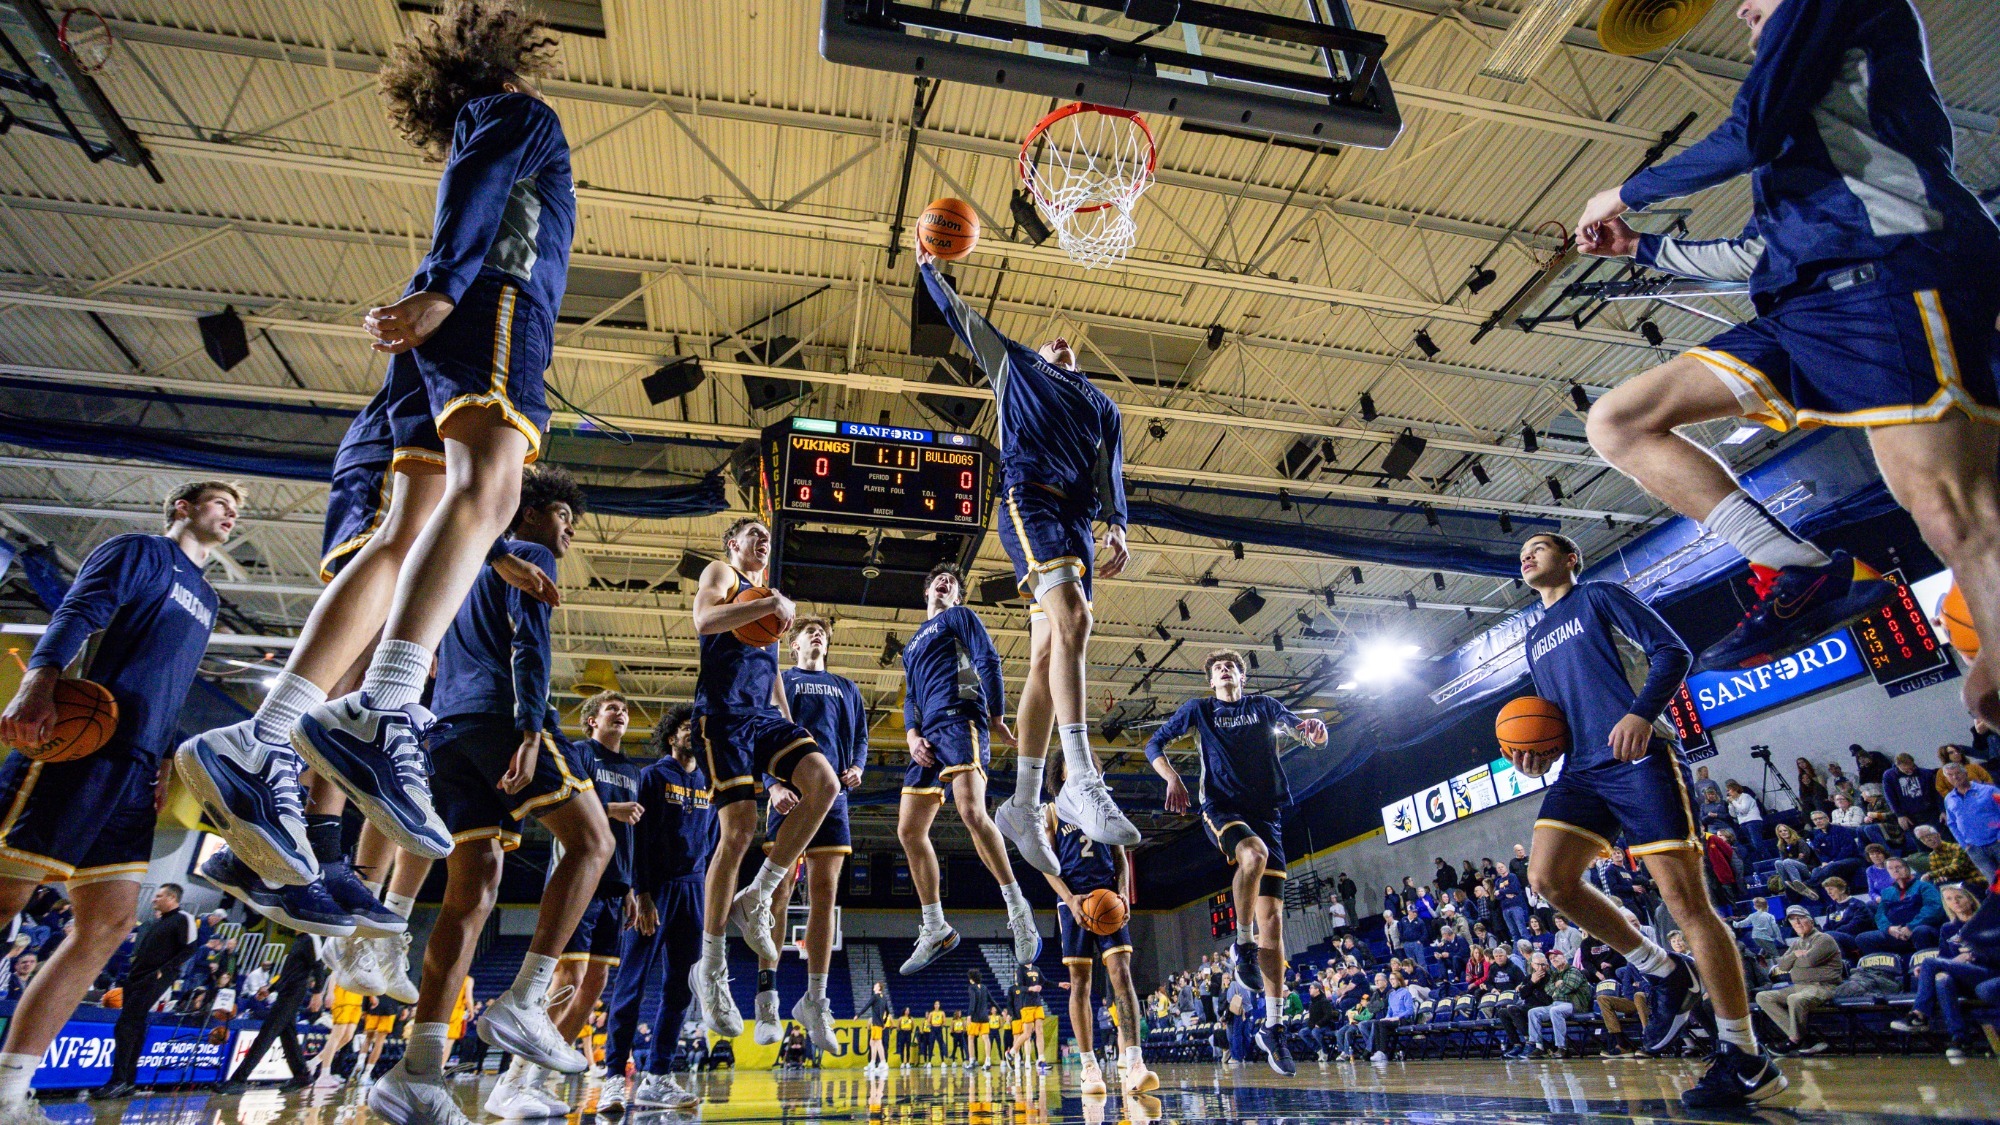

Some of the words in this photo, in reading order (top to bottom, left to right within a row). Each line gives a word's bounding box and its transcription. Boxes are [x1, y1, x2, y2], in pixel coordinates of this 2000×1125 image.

[925, 213, 962, 231] Wilson
[925, 235, 952, 248] NCAA
[849, 424, 925, 441] SANFORD
[792, 438, 851, 454] VIKINGS
[878, 448, 916, 467] 1:11
[925, 451, 974, 466] BULLDOGS
[816, 457, 828, 476] 0
[772, 441, 781, 511] AUGIE
[793, 478, 813, 486] FOULS
[868, 473, 890, 481] PERIOD
[897, 473, 902, 484] 1
[961, 471, 972, 489] 0
[800, 486, 810, 500] 0
[833, 490, 844, 503] 4
[863, 485, 886, 493] PLAYER
[890, 487, 906, 495] FOUL
[955, 493, 974, 501] FOULS
[791, 501, 811, 509] SCORE
[873, 507, 895, 516] MATCH
[924, 498, 935, 511] 4
[962, 501, 971, 515] 0
[954, 514, 973, 522] SCORE
[1903, 597, 1914, 610] 0
[1863, 628, 1877, 641] 12
[1888, 619, 1899, 632] 0
[1909, 610, 1920, 624] 0
[1532, 617, 1585, 665] AUGUSTANA
[1869, 641, 1884, 653] 13
[1894, 632, 1905, 645] 0
[1916, 623, 1927, 637] 0
[1872, 655, 1890, 669] 34
[1901, 645, 1912, 659] 0
[1923, 637, 1934, 651] 0
[1698, 637, 1847, 711] SANFORD
[1900, 671, 1944, 693] GUEST
[795, 682, 844, 698] AUGUSTANA
[1079, 834, 1094, 858] 2
